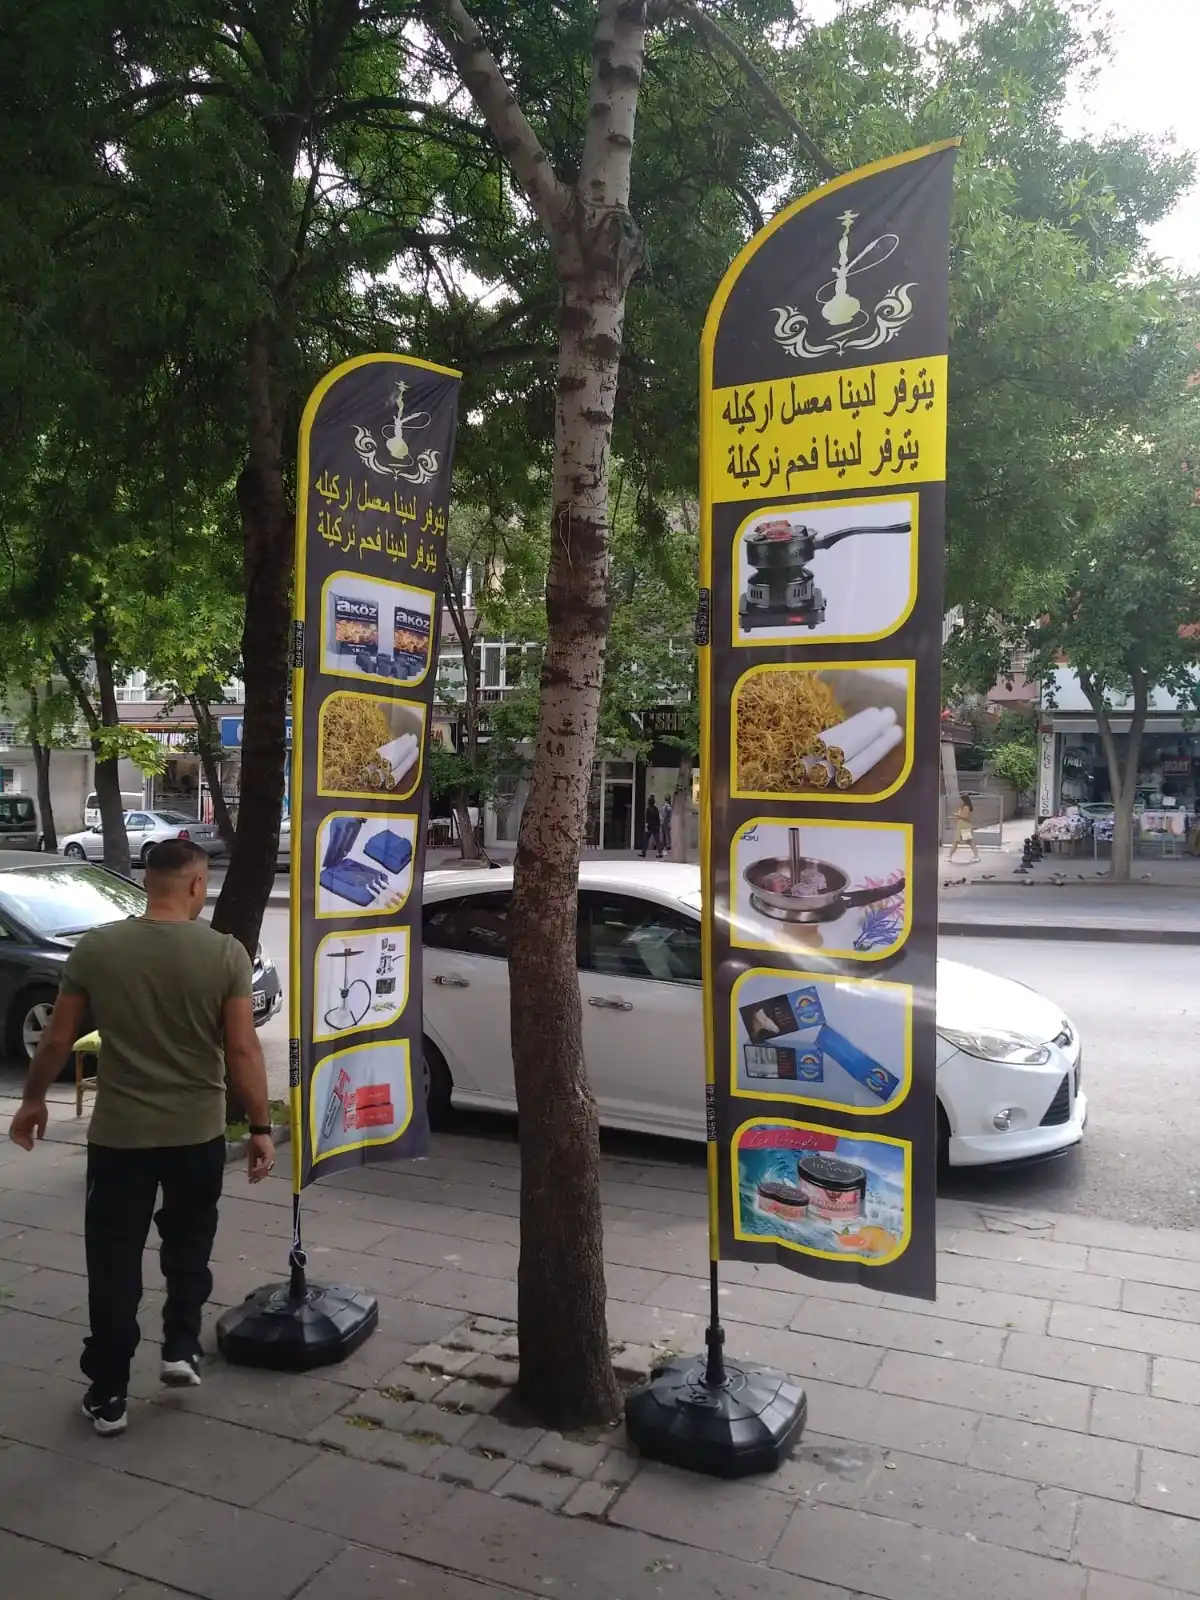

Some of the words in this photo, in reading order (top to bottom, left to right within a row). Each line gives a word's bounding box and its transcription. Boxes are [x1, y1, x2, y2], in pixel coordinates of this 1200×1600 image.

[780, 381, 832, 425] معسل
[838, 369, 876, 420] لدينا
[883, 367, 935, 417] يتوفر
[785, 436, 819, 492] فحم
[824, 428, 862, 478] لدينا
[869, 427, 919, 477] يتوفر
[356, 480, 391, 513] معسل
[393, 490, 417, 525] لدينا
[419, 501, 445, 537] يتوفر
[358, 527, 382, 561] فحم
[385, 527, 408, 563] لدينا
[410, 538, 437, 574] يتوفر
